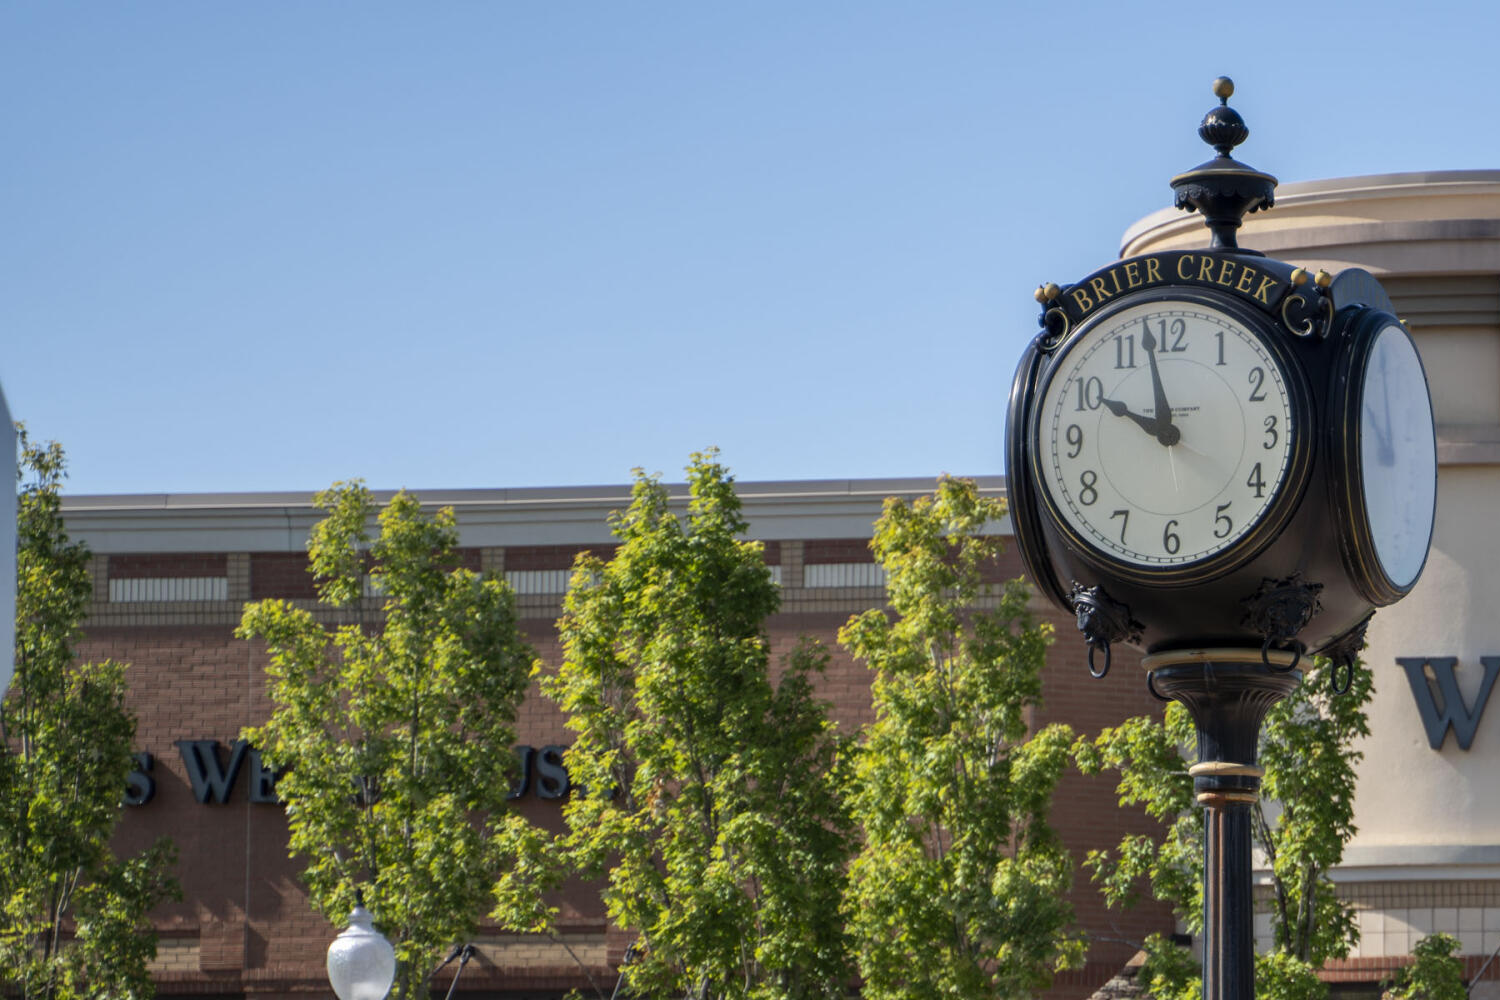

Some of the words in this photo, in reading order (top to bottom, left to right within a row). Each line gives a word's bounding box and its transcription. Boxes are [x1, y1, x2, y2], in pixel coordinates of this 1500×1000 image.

[1071, 257, 1164, 313] BRIER
[1177, 254, 1278, 305] CREEK
[1112, 334, 1137, 370] 11
[1157, 318, 1190, 353] 12
[1214, 331, 1227, 366] 1
[1074, 376, 1104, 411] 10
[1248, 366, 1268, 402] 2
[1066, 424, 1083, 459] 9
[1263, 415, 1279, 450] 3
[1079, 470, 1098, 506] 8
[1247, 462, 1267, 498] 4
[1109, 510, 1130, 546] 7
[1163, 520, 1180, 555] 6
[1213, 501, 1233, 538] 5
